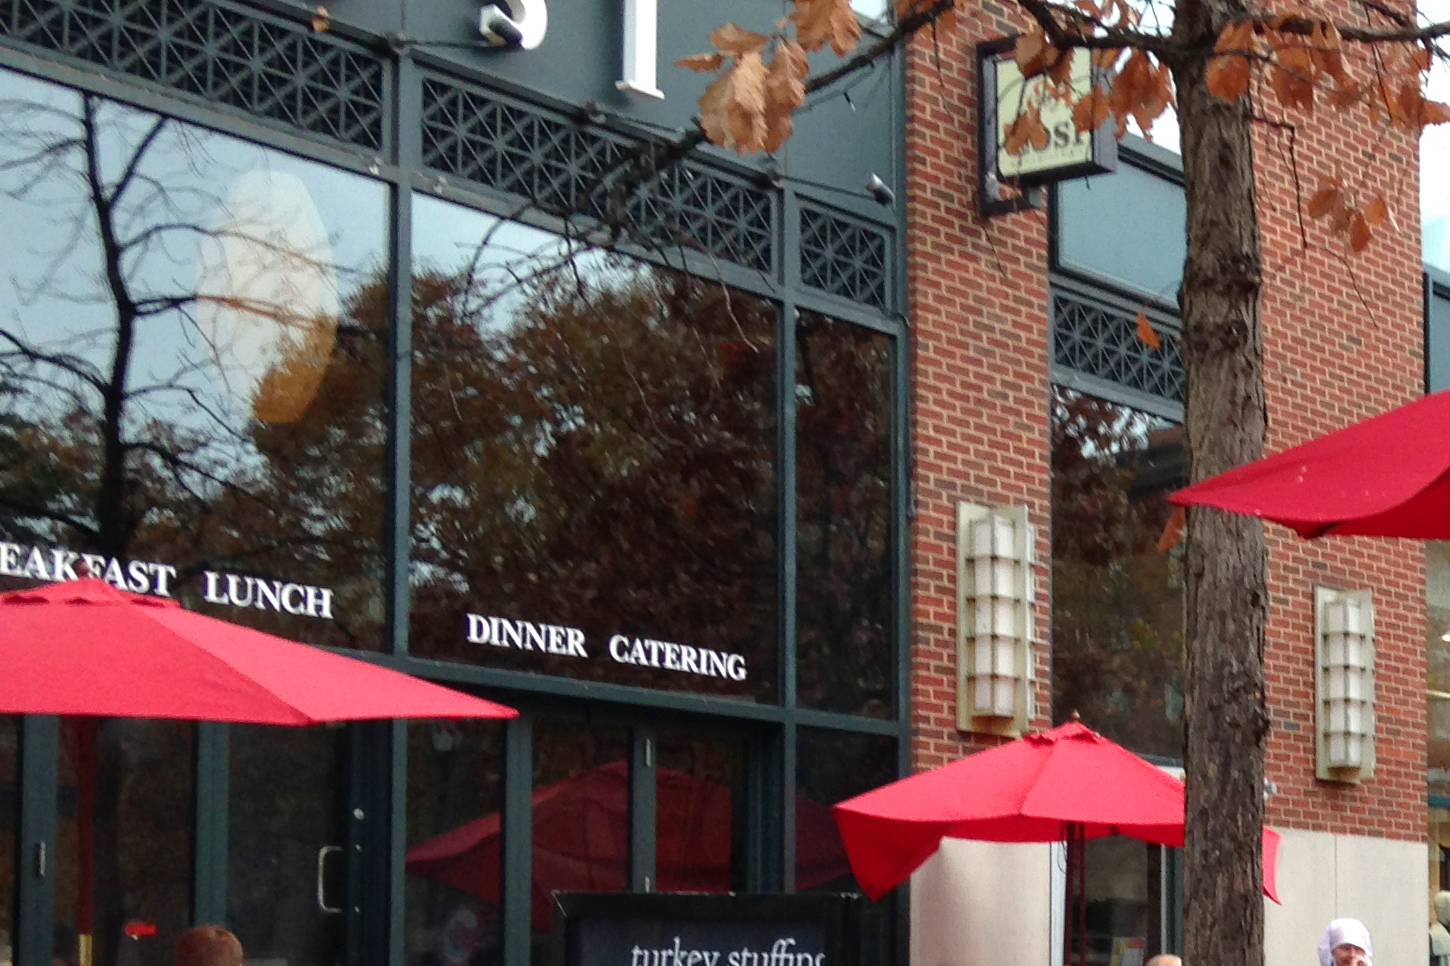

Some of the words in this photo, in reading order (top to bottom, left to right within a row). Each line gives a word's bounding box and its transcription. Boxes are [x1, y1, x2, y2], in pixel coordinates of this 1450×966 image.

[204, 570, 334, 619] LUNCH
[466, 613, 588, 658] DINNER
[609, 634, 748, 681] CATERING
